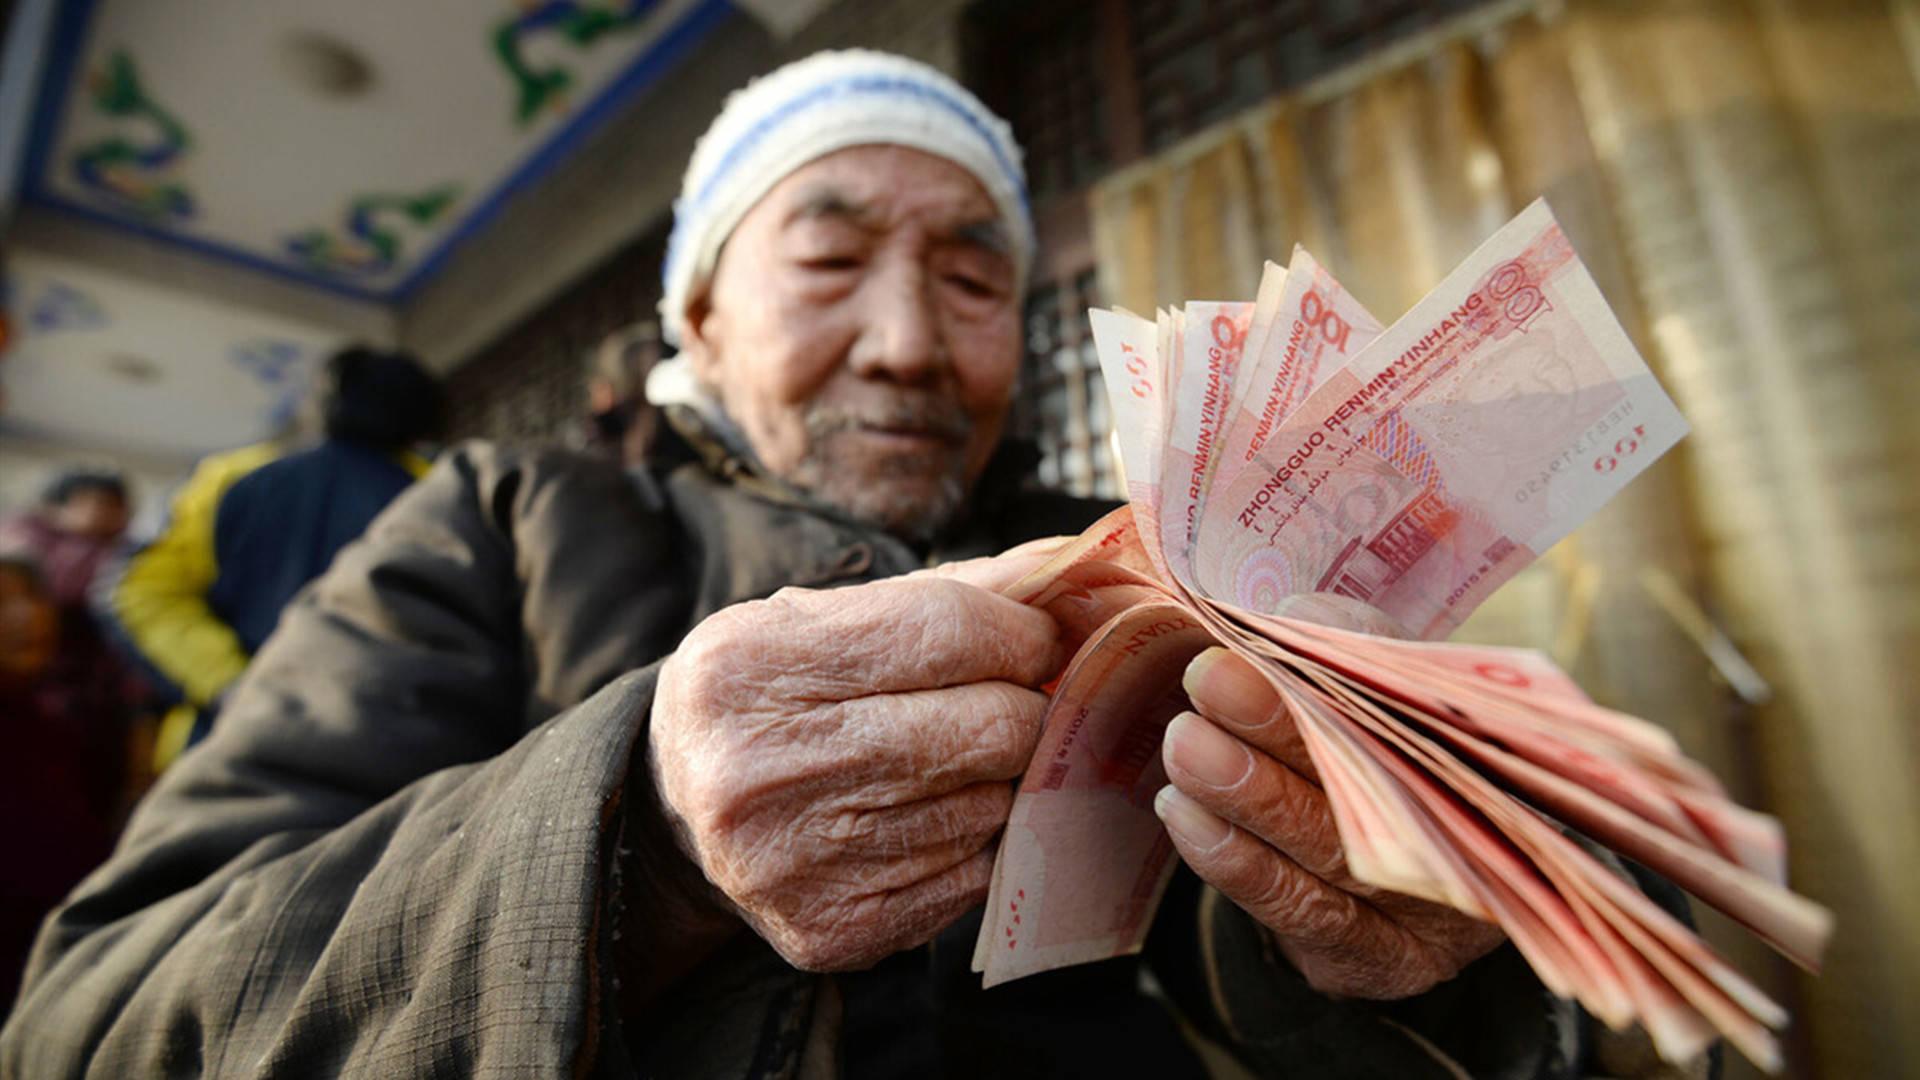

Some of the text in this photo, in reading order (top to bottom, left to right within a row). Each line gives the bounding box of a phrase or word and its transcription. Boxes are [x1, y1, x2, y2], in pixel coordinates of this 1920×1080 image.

[1300, 290, 1352, 353] 100
[1486, 261, 1553, 334] 100
[1201, 346, 1223, 426] YINHANG
[1271, 319, 1304, 400] YINHANG
[1238, 430, 1325, 528] ZHONGGUO
[1324, 366, 1397, 432] RENMIN
[1392, 293, 1484, 372] YINHANG
